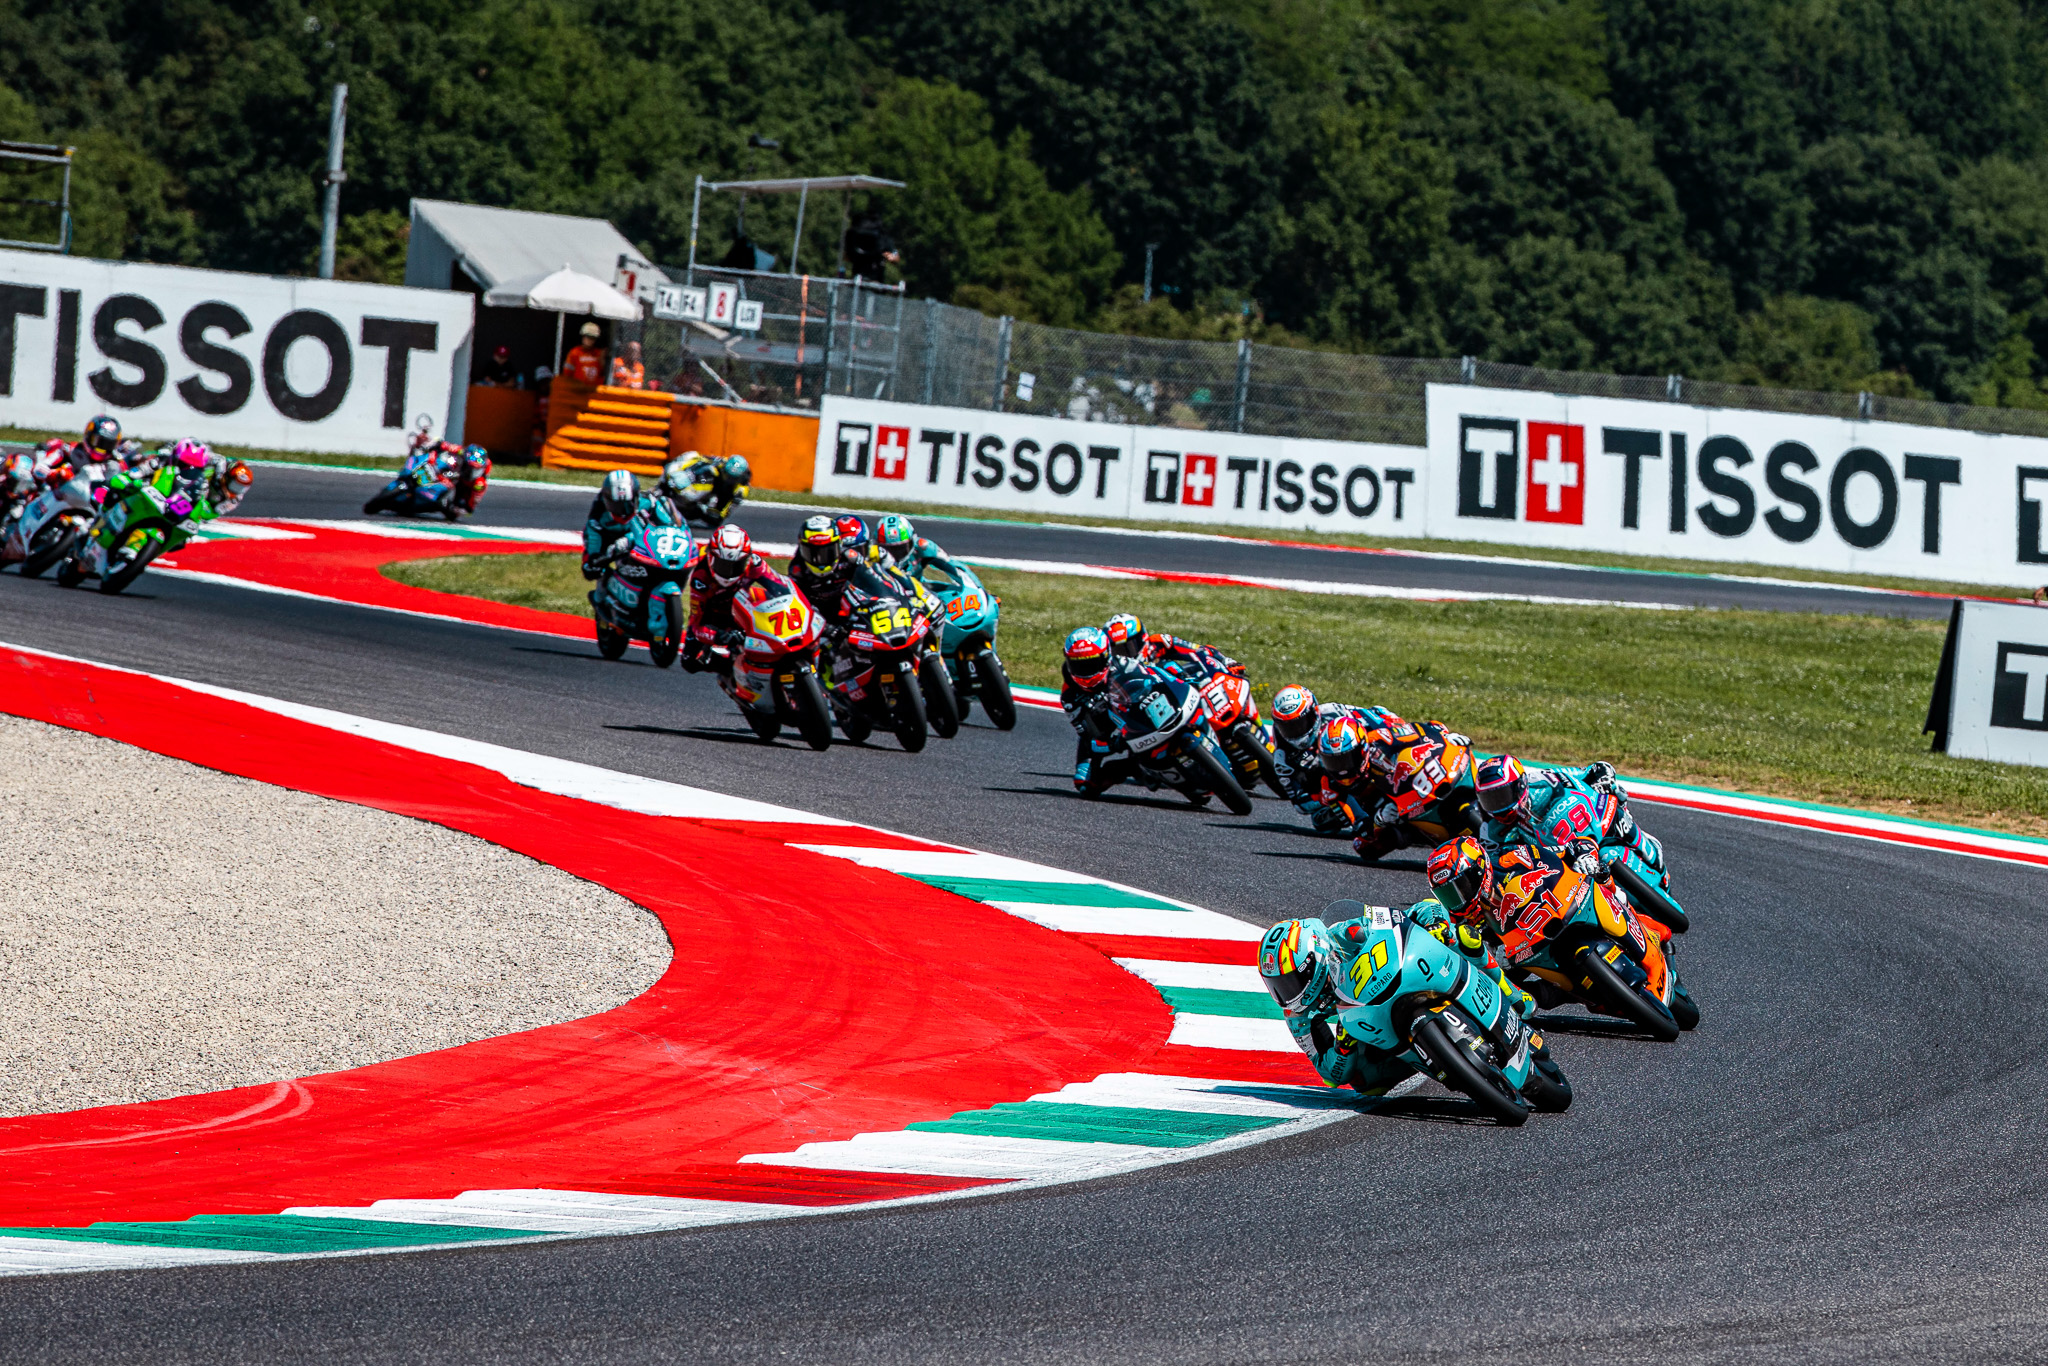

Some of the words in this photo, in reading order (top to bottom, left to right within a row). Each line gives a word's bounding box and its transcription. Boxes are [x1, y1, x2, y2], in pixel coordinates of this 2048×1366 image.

[0, 282, 439, 428] TISSOT
[919, 429, 1121, 499] TISSOT
[1227, 455, 1415, 520] TISSOT
[1602, 426, 1962, 555] TISSOT
[656, 535, 690, 557] 97
[769, 607, 803, 636] 78
[947, 594, 981, 621] 94
[1412, 757, 1447, 798] 83
[1552, 802, 1593, 846] 28
[1515, 888, 1563, 940] 51
[1349, 939, 1389, 1000] 31
[1367, 972, 1393, 999] LEOPARD
[1330, 1055, 1348, 1083] LEOPAR
